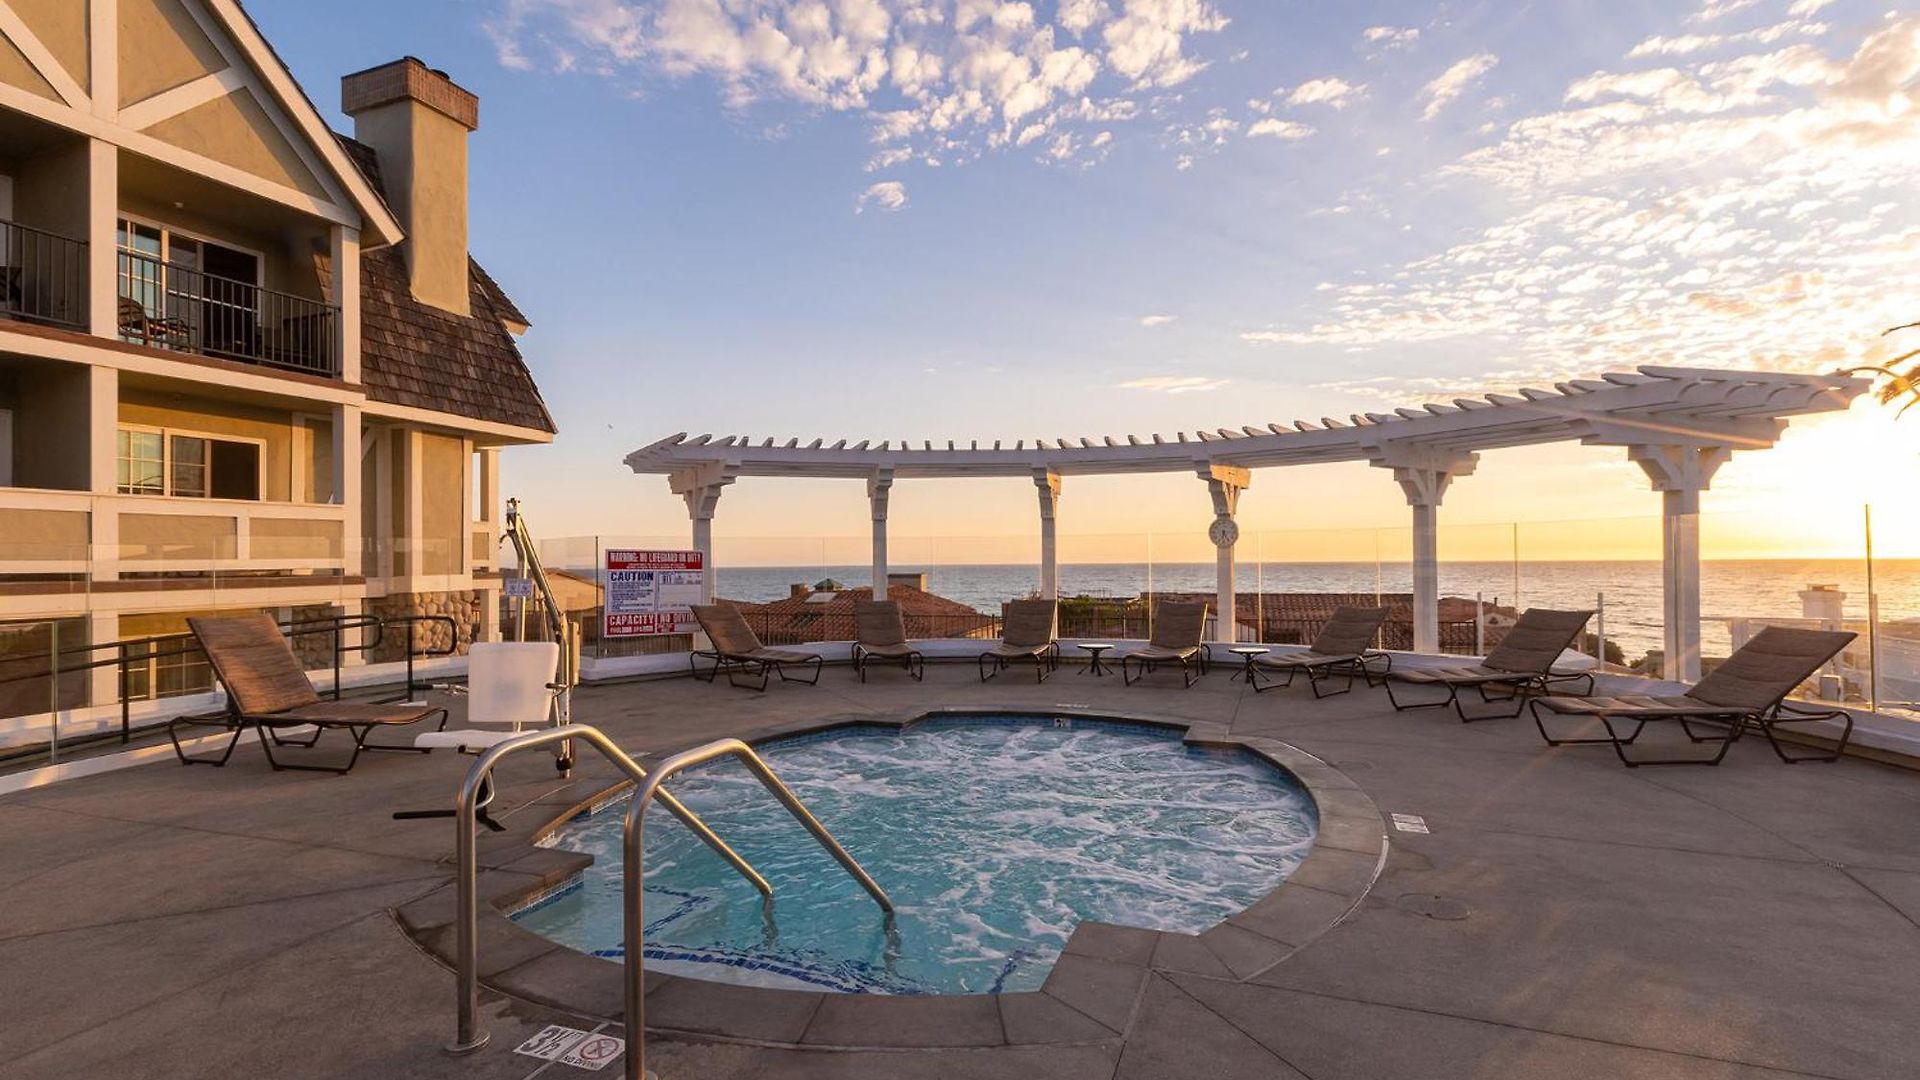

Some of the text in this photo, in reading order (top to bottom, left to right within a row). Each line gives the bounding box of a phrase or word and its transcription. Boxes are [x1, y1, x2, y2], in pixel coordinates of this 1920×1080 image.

[640, 552, 648, 562] NO
[649, 552, 678, 563] LIFEGUARD
[679, 552, 686, 563] ON
[687, 552, 701, 563] DUTY
[611, 571, 654, 581] CAUTION
[609, 614, 654, 626] CAPACITY
[660, 613, 697, 623] NO DIVIN
[563, 1055, 576, 1063] NO
